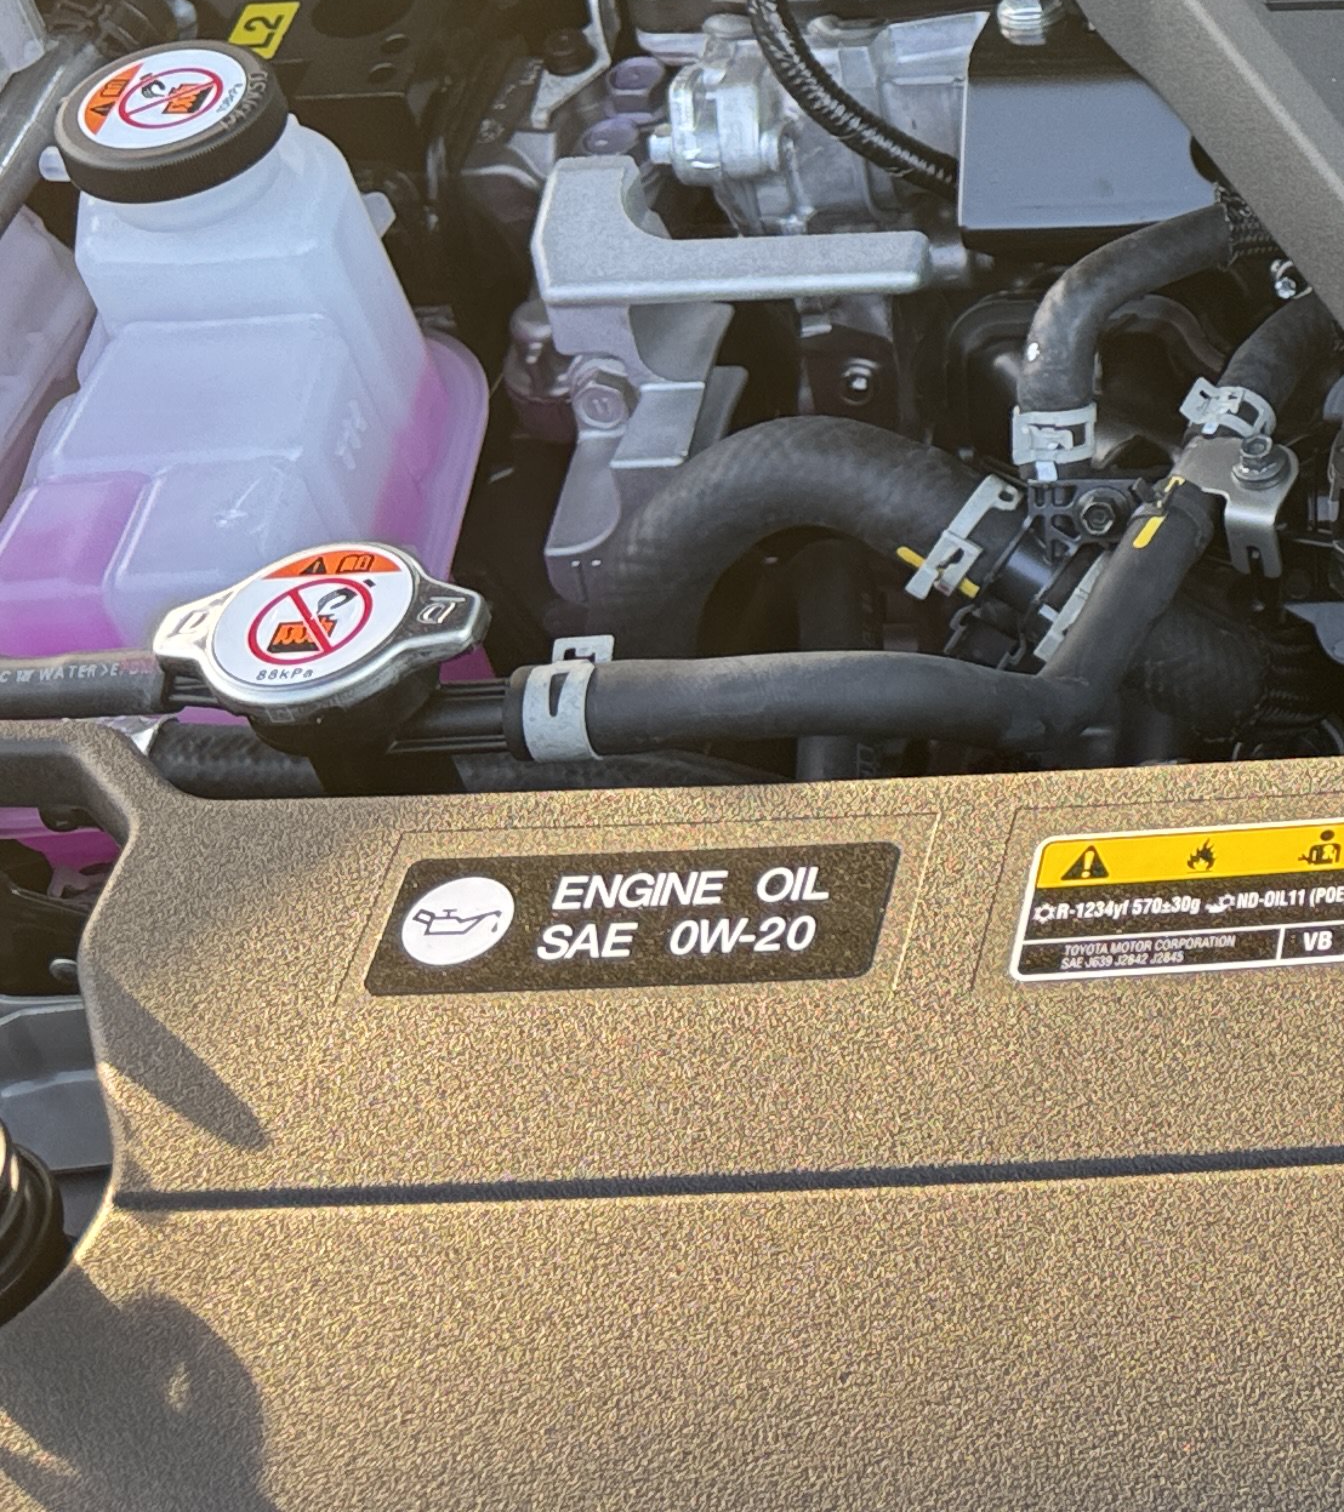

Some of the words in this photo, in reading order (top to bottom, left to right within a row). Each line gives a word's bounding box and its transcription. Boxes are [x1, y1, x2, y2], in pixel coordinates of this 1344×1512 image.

[243, 14, 285, 49] L2
[256, 667, 314, 681] 88kPa
[552, 870, 728, 910] ENGINE
[756, 866, 829, 903] OIL
[1236, 889, 1306, 909] ND-OIL11
[536, 921, 639, 960] SAE
[669, 915, 817, 956] 0W-20
[1064, 941, 1108, 957] TOYOTA
[1109, 940, 1153, 954] MOTOR
[1154, 935, 1236, 952] CORPORATION
[1303, 930, 1334, 952] VB
[1061, 956, 1084, 970] SAE
